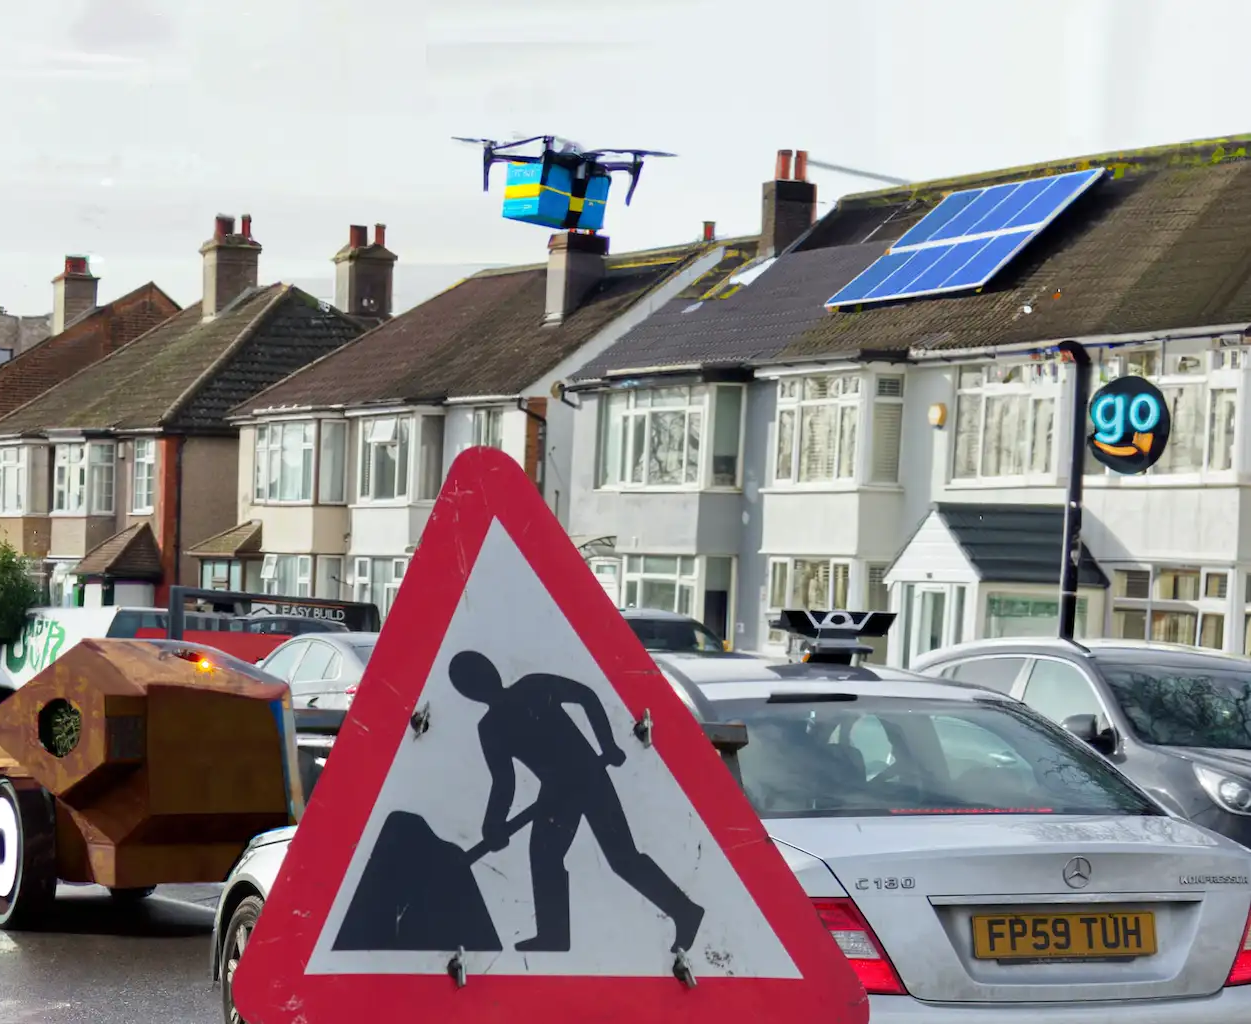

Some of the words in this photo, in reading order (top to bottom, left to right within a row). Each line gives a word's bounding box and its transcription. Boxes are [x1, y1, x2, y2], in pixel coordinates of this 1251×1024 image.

[1090, 392, 1161, 443] go
[280, 604, 311, 617] EASY
[313, 607, 346, 621] BUILD
[855, 877, 869, 890] C
[873, 876, 916, 890] 180
[987, 917, 1071, 952] FP59
[1079, 916, 1142, 950] TUH
